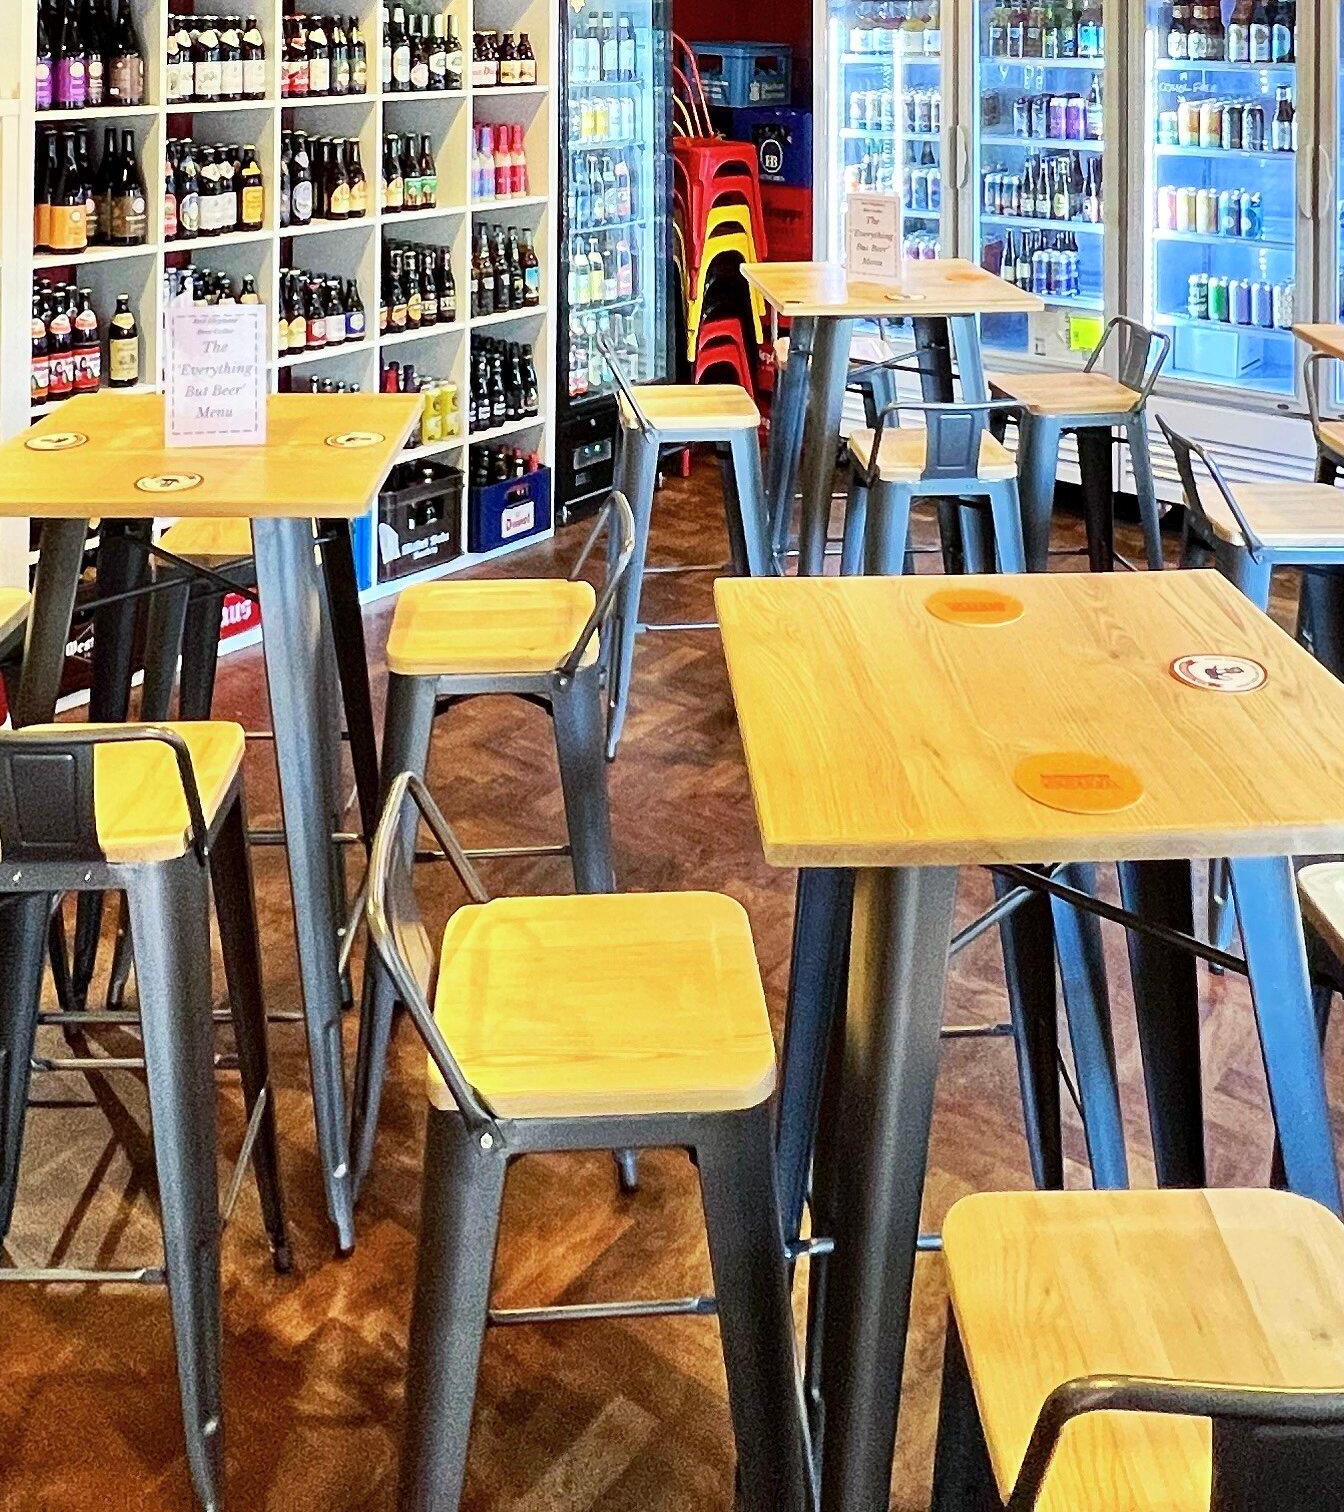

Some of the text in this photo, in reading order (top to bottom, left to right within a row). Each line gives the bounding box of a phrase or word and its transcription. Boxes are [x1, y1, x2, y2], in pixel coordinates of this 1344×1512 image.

[202, 339, 229, 353] The
[184, 385, 209, 397] But
[195, 406, 234, 419] Menu
